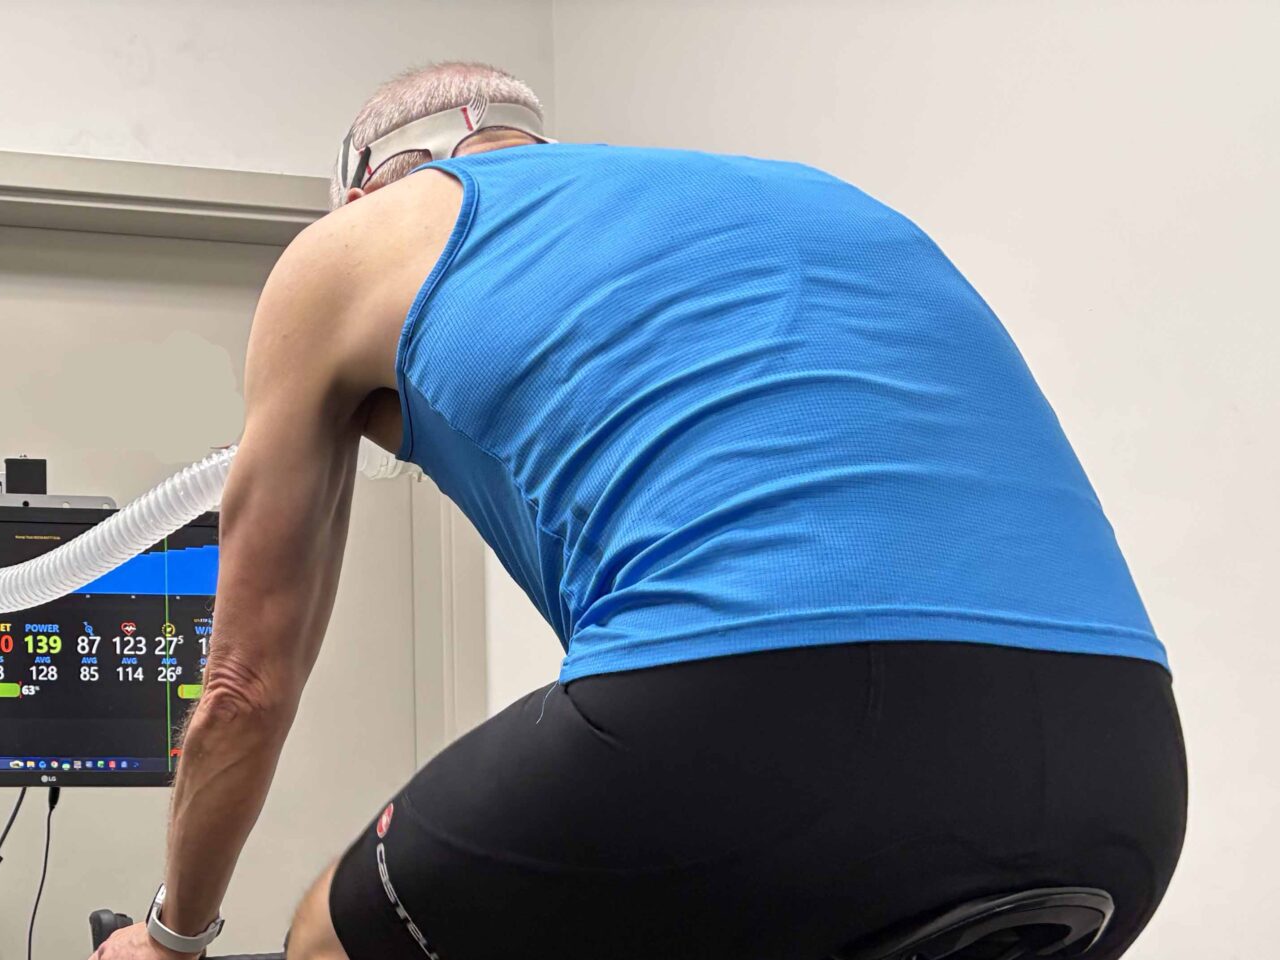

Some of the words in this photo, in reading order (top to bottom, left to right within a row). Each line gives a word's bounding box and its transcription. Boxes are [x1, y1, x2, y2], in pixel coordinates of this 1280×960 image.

[25, 624, 59, 633] POWER
[24, 635, 62, 654] 139
[77, 635, 101, 655] 87
[112, 636, 147, 655] 123
[34, 656, 51, 664] AVG
[121, 657, 138, 665] AVG
[29, 665, 58, 681] 128
[80, 666, 99, 681] 85
[116, 666, 144, 681] 114
